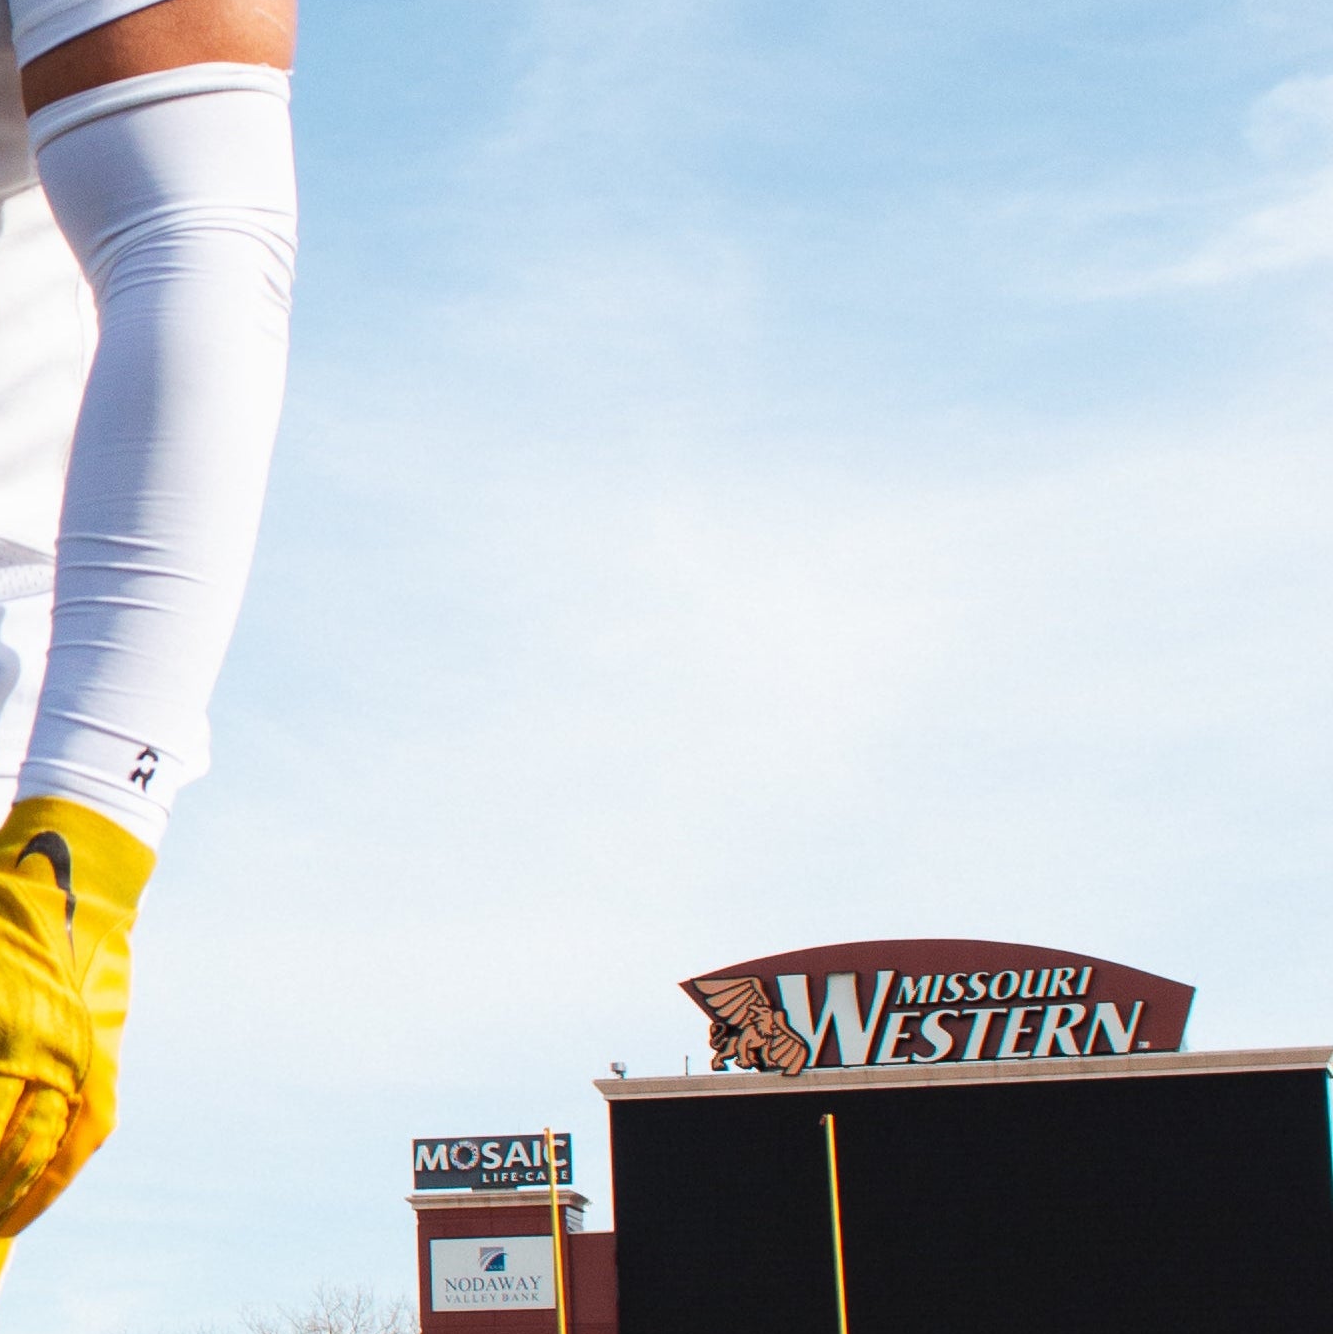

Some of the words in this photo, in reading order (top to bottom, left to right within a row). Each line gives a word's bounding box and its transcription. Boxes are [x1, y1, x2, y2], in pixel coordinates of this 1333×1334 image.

[895, 966, 1093, 1006] MISSOURI
[776, 969, 1145, 1067] WESTERN
[414, 1139, 568, 1172] MOSAIC
[444, 1275, 543, 1293] NODAWAY
[445, 1292, 497, 1304] VALLEY
[502, 1292, 541, 1304] BANK
